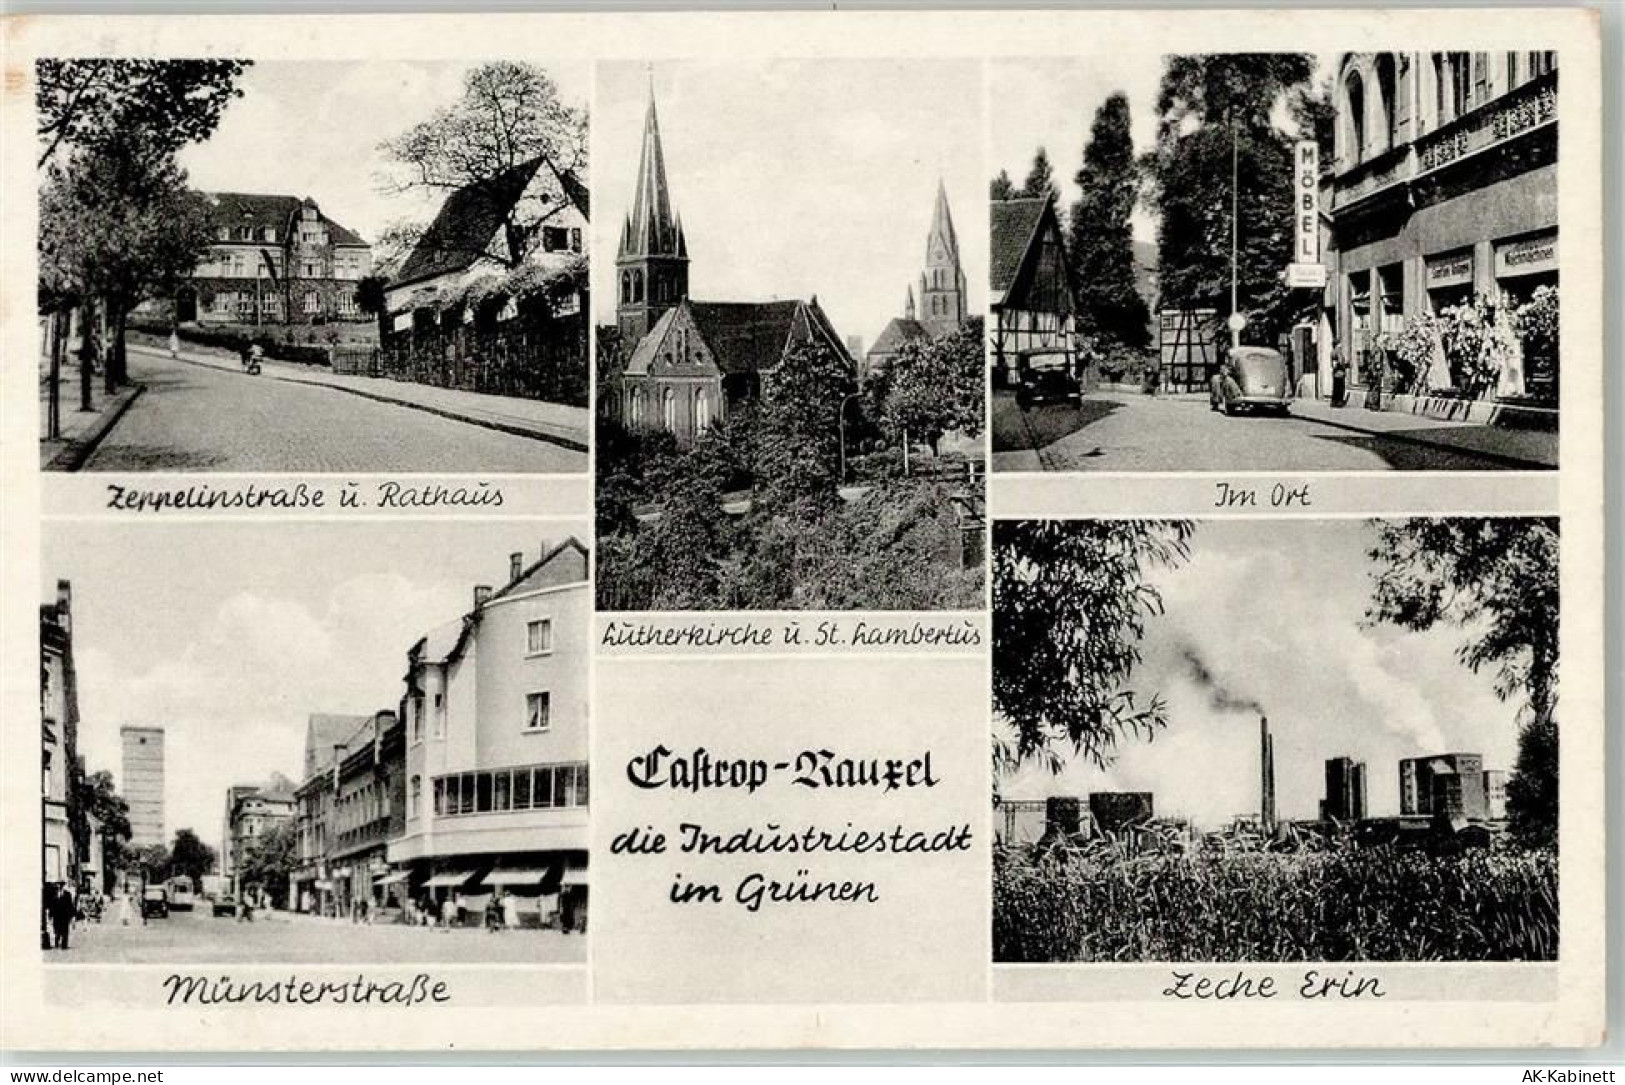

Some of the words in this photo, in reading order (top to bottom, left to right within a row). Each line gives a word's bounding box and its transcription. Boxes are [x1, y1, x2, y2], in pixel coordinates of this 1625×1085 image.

[1301, 147, 1314, 256] MÖBEL
[1271, 482, 1312, 508] Ort
[814, 621, 846, 646] St.
[609, 825, 667, 855] die
[669, 873, 723, 903] im
[735, 869, 880, 913] Grünen
[162, 973, 452, 1008] Münsterstraße
[1162, 970, 1278, 1000] Zeche
[1299, 970, 1386, 999] Erin
